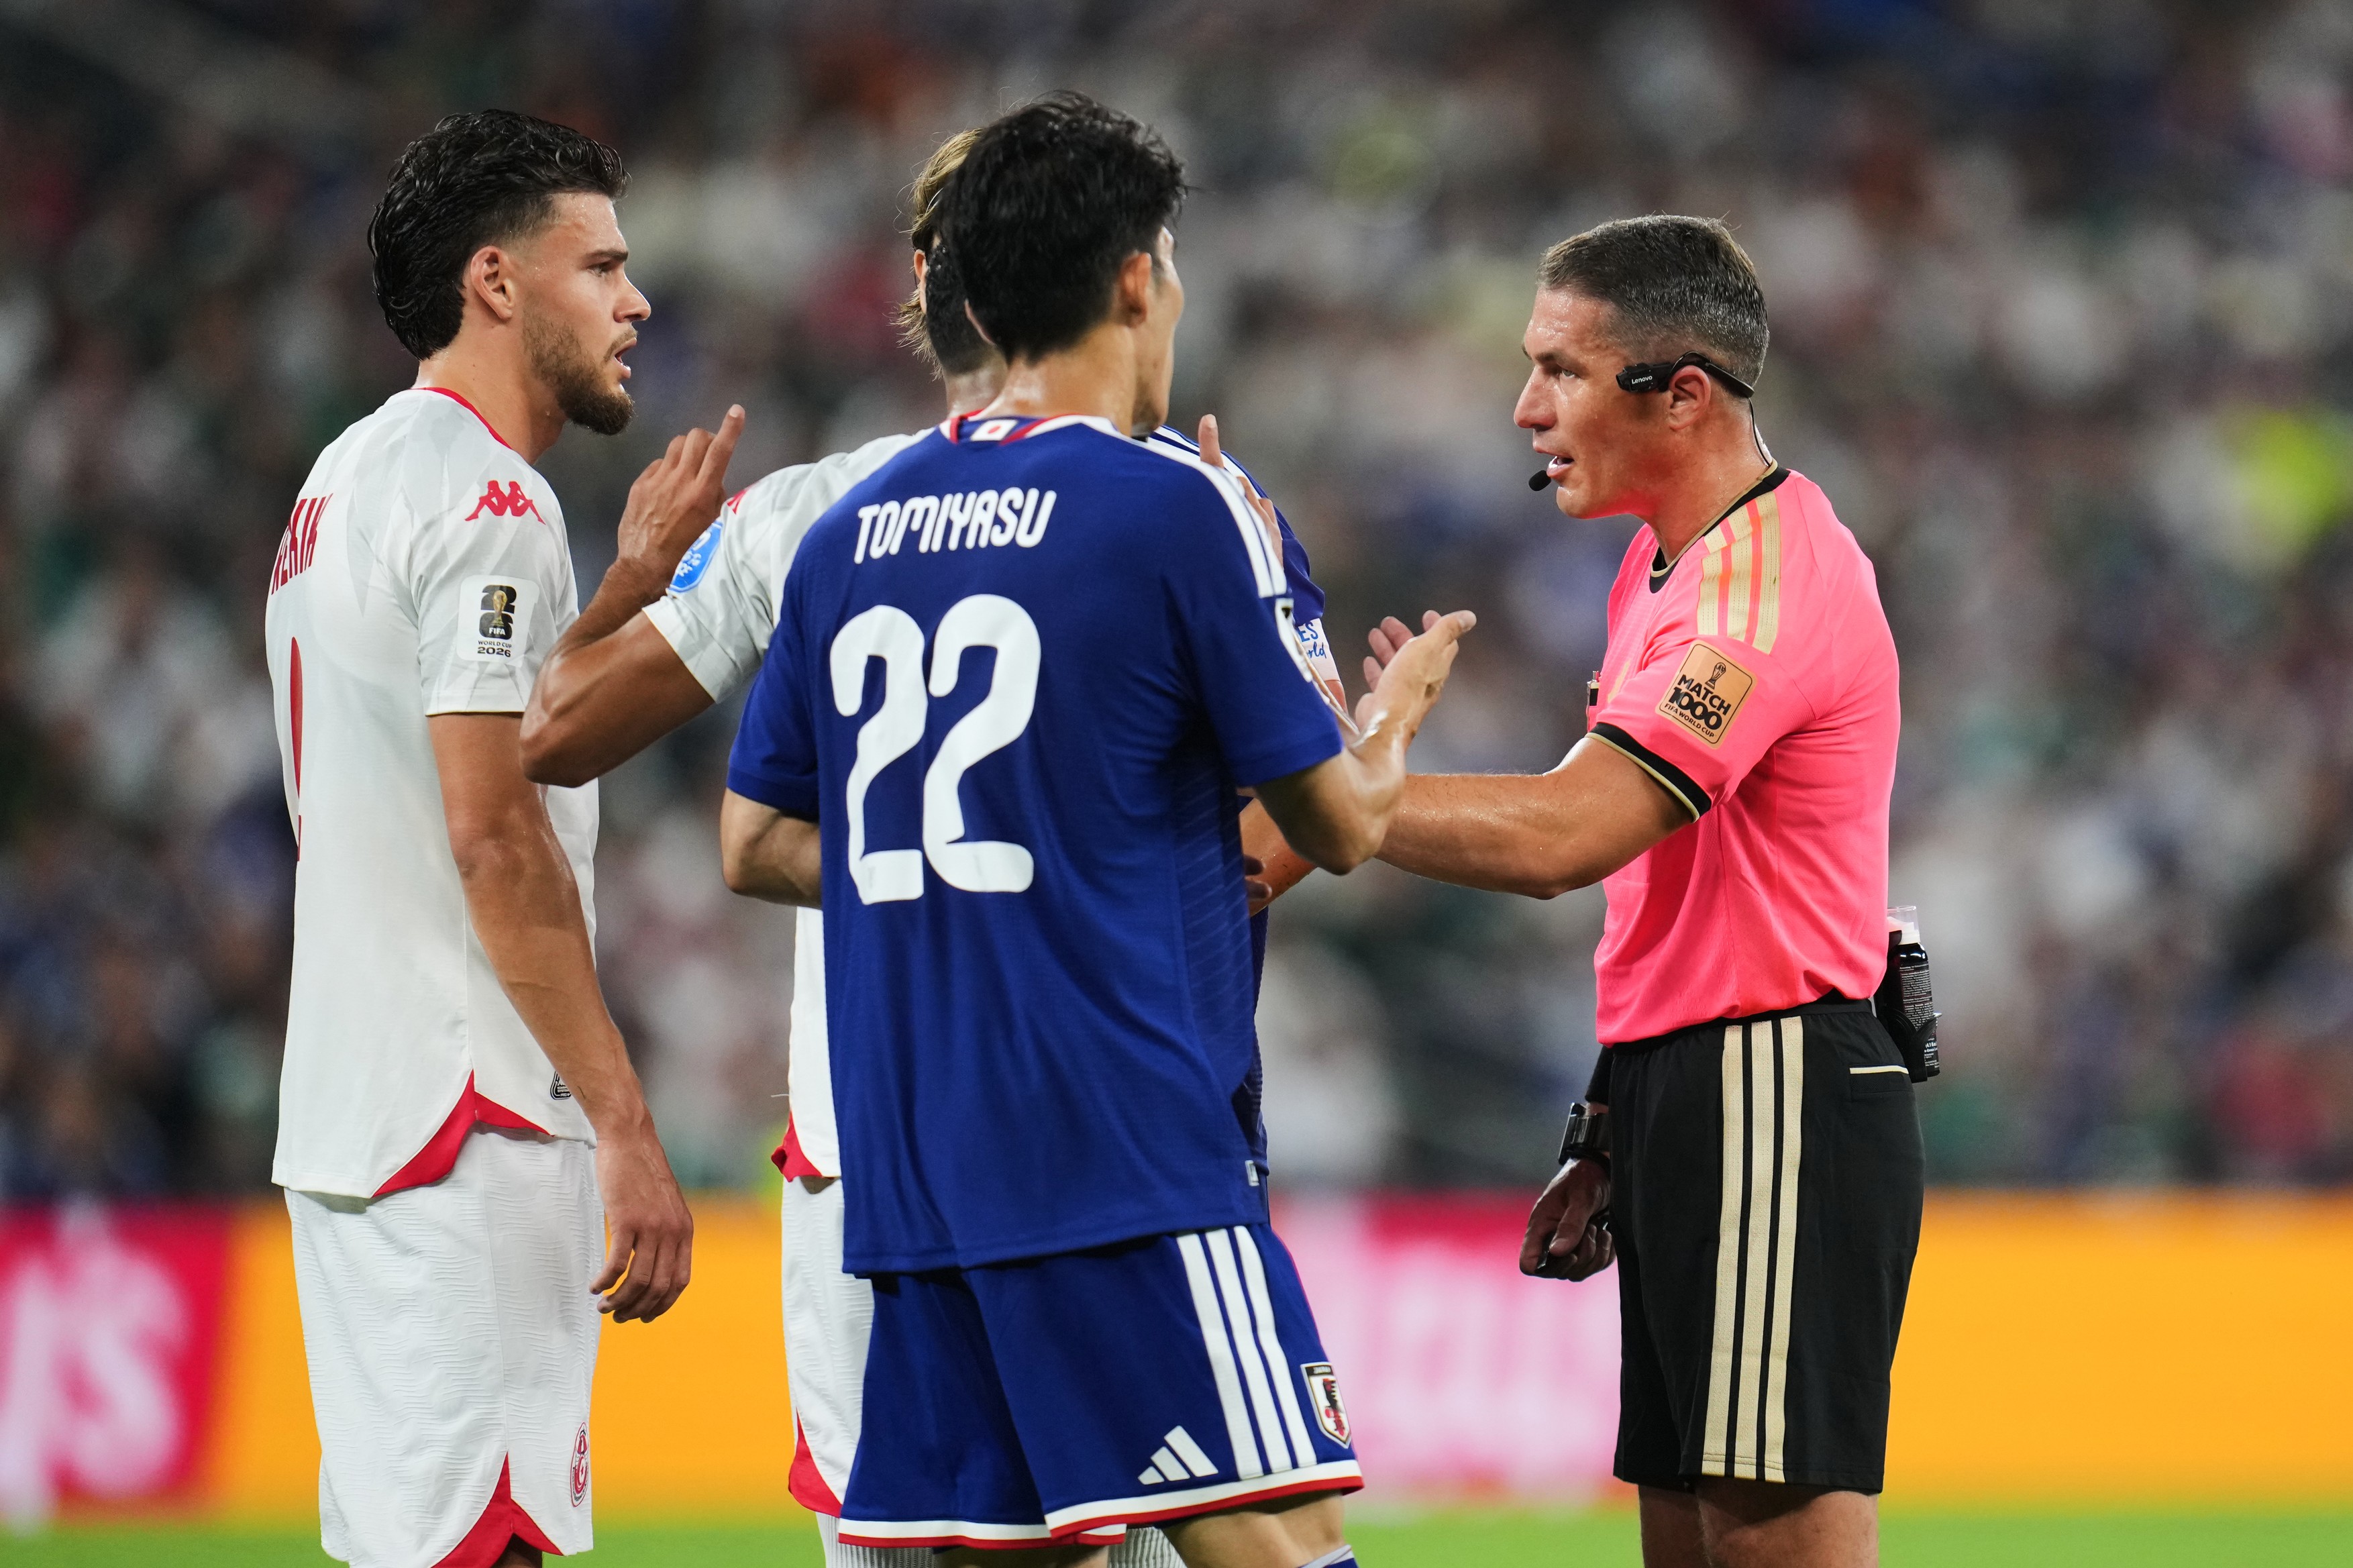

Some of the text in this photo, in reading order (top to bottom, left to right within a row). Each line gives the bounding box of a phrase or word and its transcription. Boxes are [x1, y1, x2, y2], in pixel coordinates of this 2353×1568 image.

[1631, 375, 1653, 384] Lenovo
[853, 486, 1057, 565] TOMIYASU
[488, 627, 506, 635] FIFA
[477, 647, 511, 658] 2026
[1669, 686, 1722, 730] 1000
[1677, 674, 1732, 716] MATCH
[1664, 703, 1715, 737] FIFA WORLD CUP
[829, 593, 1041, 905] 22
